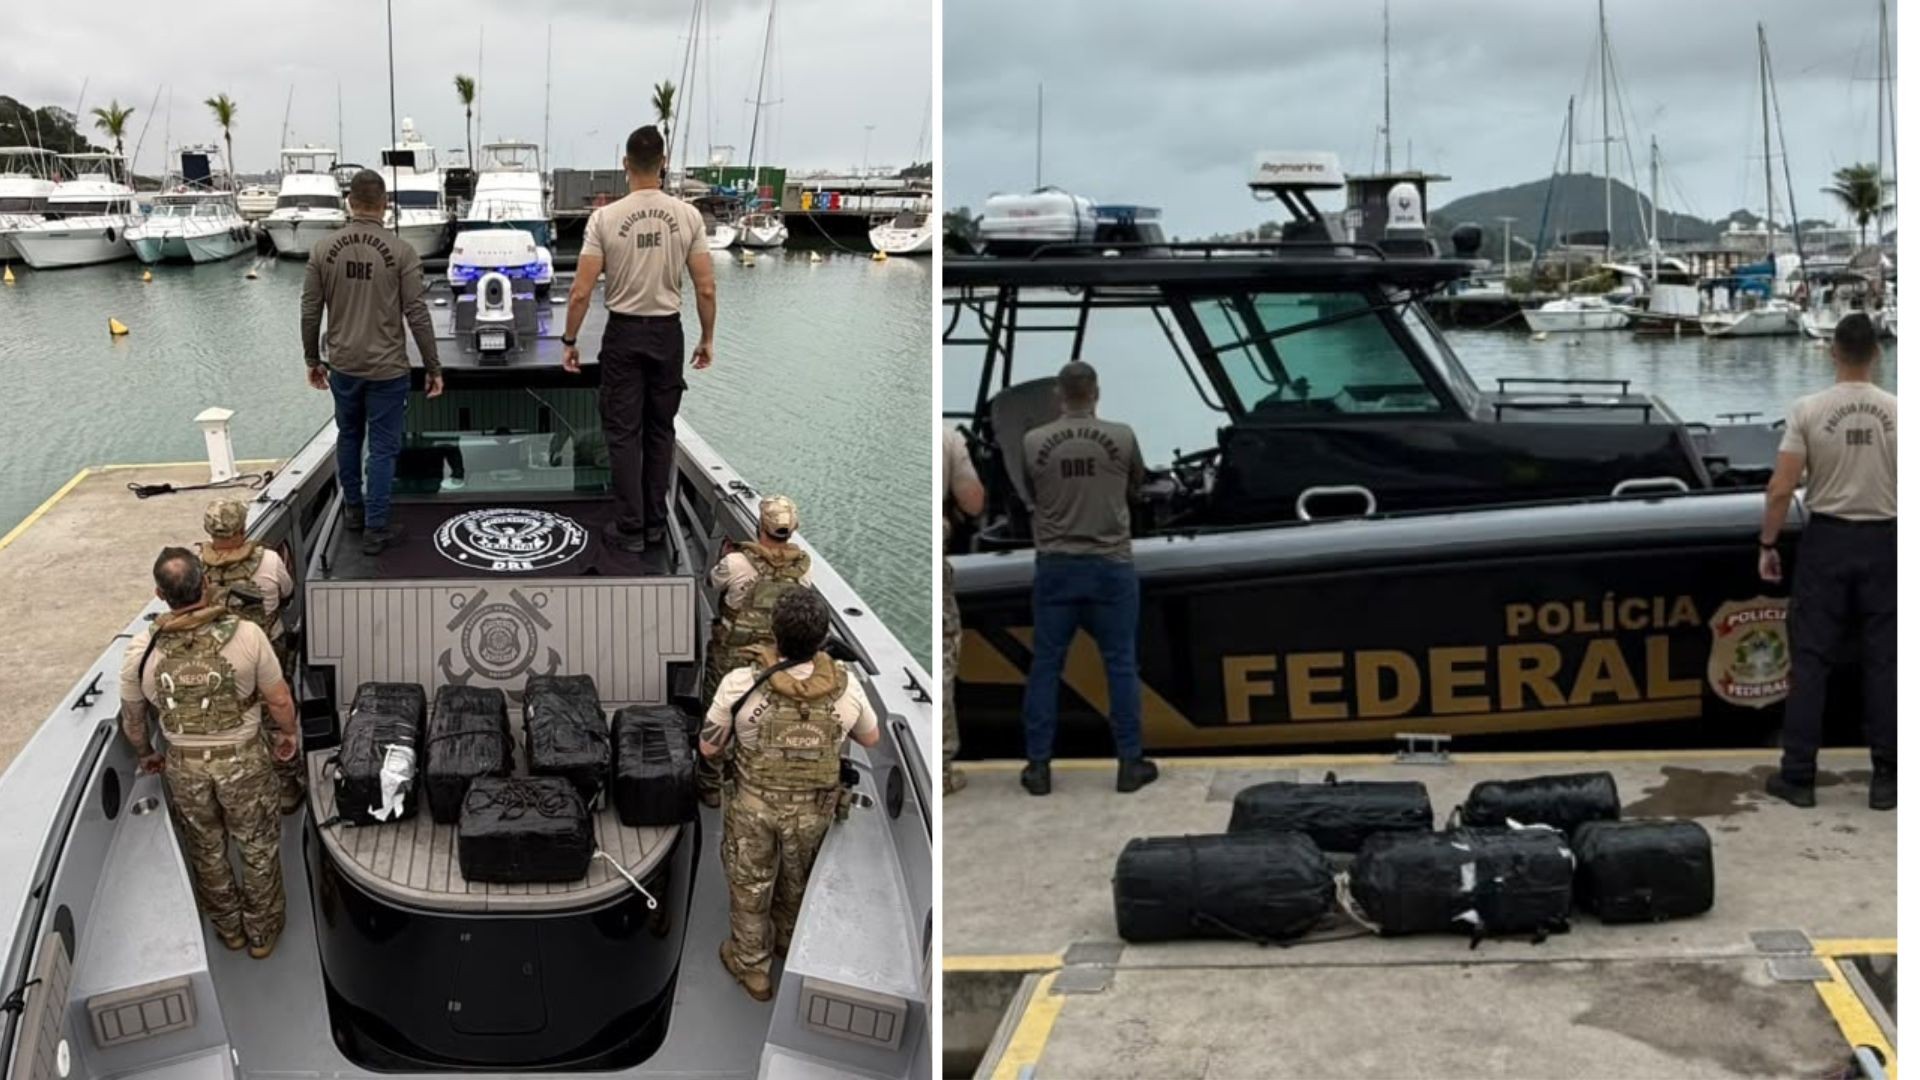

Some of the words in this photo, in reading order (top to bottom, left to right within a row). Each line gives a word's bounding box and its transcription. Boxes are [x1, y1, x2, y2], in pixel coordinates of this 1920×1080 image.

[648, 208, 680, 234] FEDERAL
[361, 233, 396, 268] FEDERAL
[637, 231, 662, 249] DRE
[346, 260, 373, 280] DRE
[1845, 428, 1873, 446] DRE
[1060, 457, 1097, 479] DRE
[492, 560, 534, 571] DRE
[1505, 591, 1699, 636] POLÍCIA
[1222, 635, 1703, 723] FEDERAL
[785, 736, 820, 747] NEPOM
